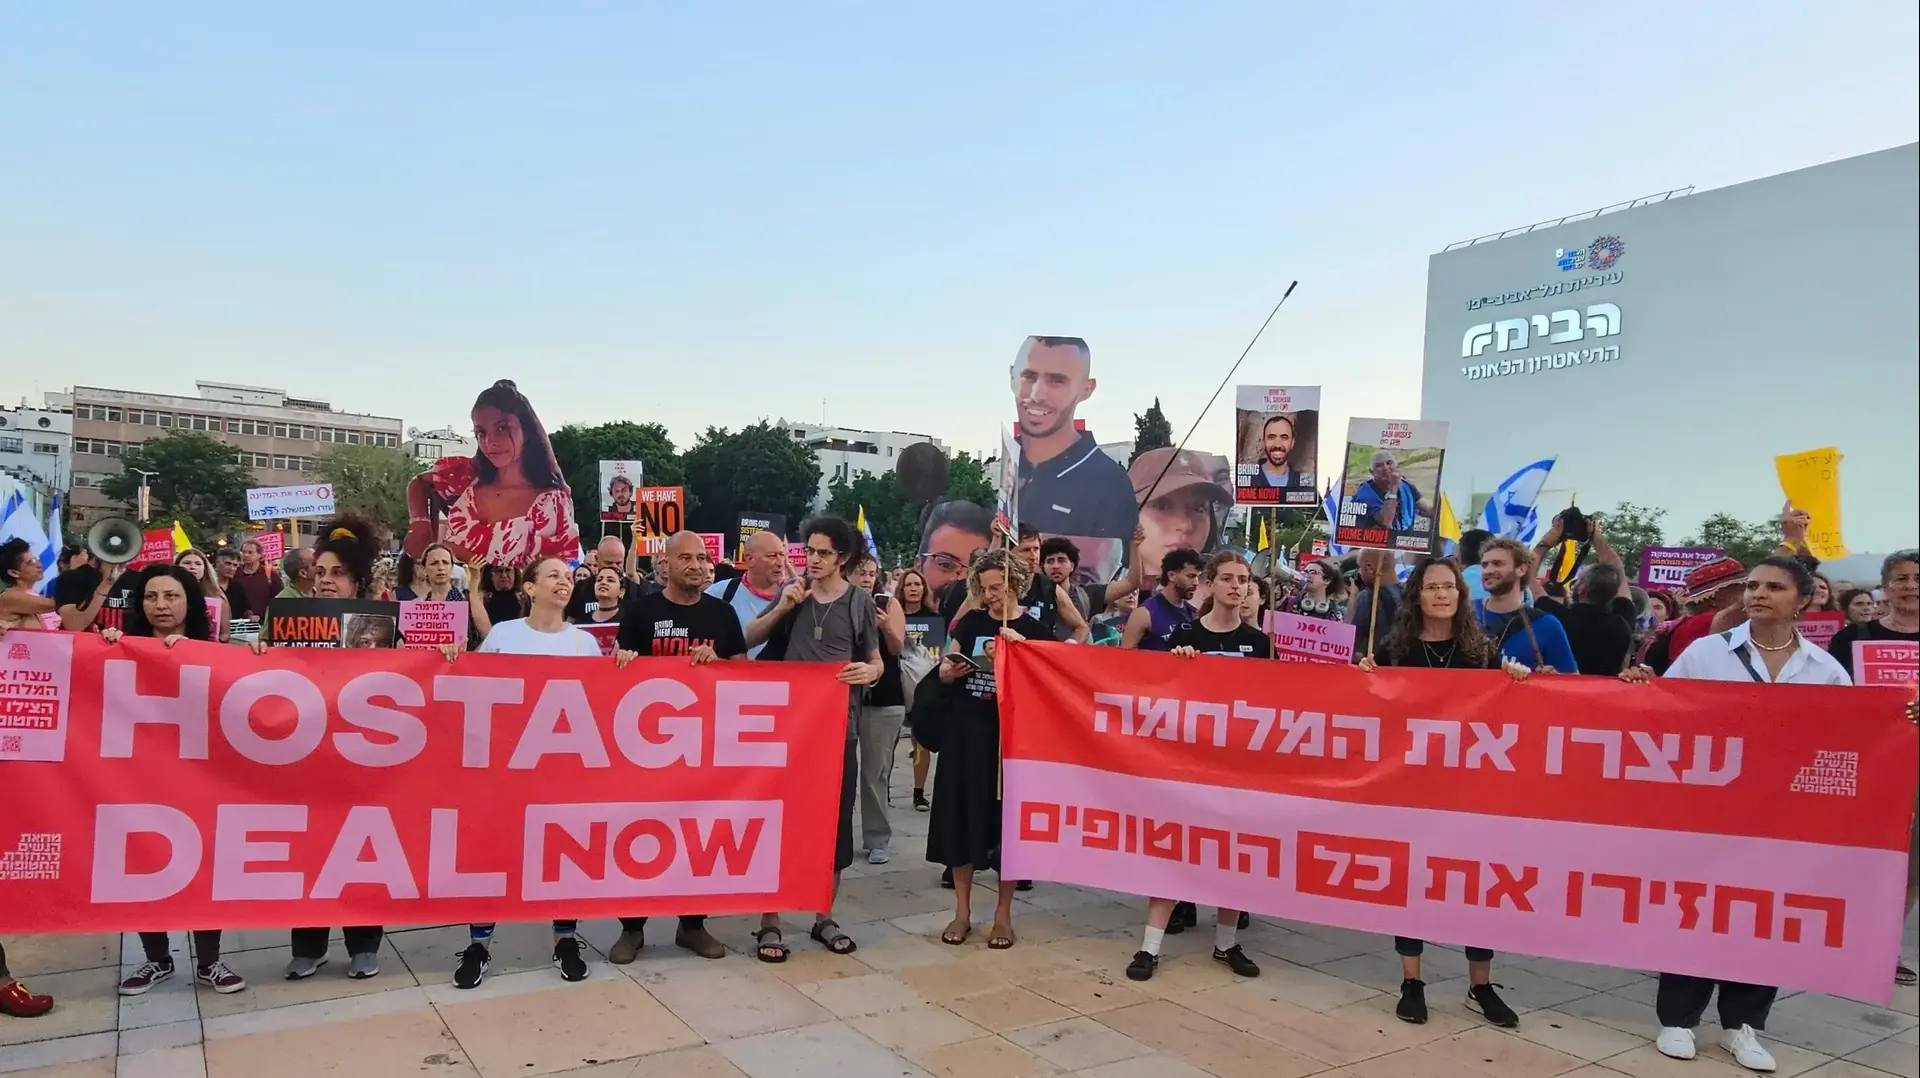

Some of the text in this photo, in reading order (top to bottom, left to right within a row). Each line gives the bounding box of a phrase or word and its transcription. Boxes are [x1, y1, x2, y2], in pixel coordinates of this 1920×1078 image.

[1568, 271, 1623, 292] עיריית
[1461, 345, 1620, 380] התיאטרון הלאומי
[1238, 464, 1259, 475] BRING
[1238, 475, 1251, 486] HIM
[641, 490, 677, 501] WE HAVE
[1238, 488, 1257, 499] HOME
[1258, 488, 1279, 499] NOW!
[1341, 501, 1367, 515] BRING
[641, 501, 679, 537] NO
[1339, 514, 1356, 527] HIM
[1338, 528, 1388, 542] HOME NOW!
[143, 541, 170, 550] TAGE
[646, 538, 666, 554] TIM
[1653, 568, 1682, 581] שיו
[415, 602, 445, 611] לחימה
[405, 612, 455, 620] לא מחזירה
[273, 616, 341, 641] KARINA
[654, 619, 673, 631] BRING
[406, 633, 453, 642] רק עסקה
[654, 627, 689, 638] THEM HOME
[1320, 641, 1350, 657] נשים
[13, 670, 52, 682] עצרו
[6, 701, 53, 714] הצילו
[100, 659, 791, 769] HOSTAGE
[1093, 691, 1745, 787] עצרו את המלחמה
[1816, 750, 1859, 760] מחאת
[1814, 759, 1858, 769] הנשים
[1799, 767, 1857, 778] להחזרת
[1793, 774, 1857, 787] החטופות
[1790, 783, 1856, 796] והחטופים
[20, 833, 61, 843] מחאת
[18, 842, 61, 852] הנשים
[91, 802, 765, 903] DEAL NOW
[3, 851, 61, 861] להחזרת
[1019, 801, 1846, 949] החזירו את כל החטופים
